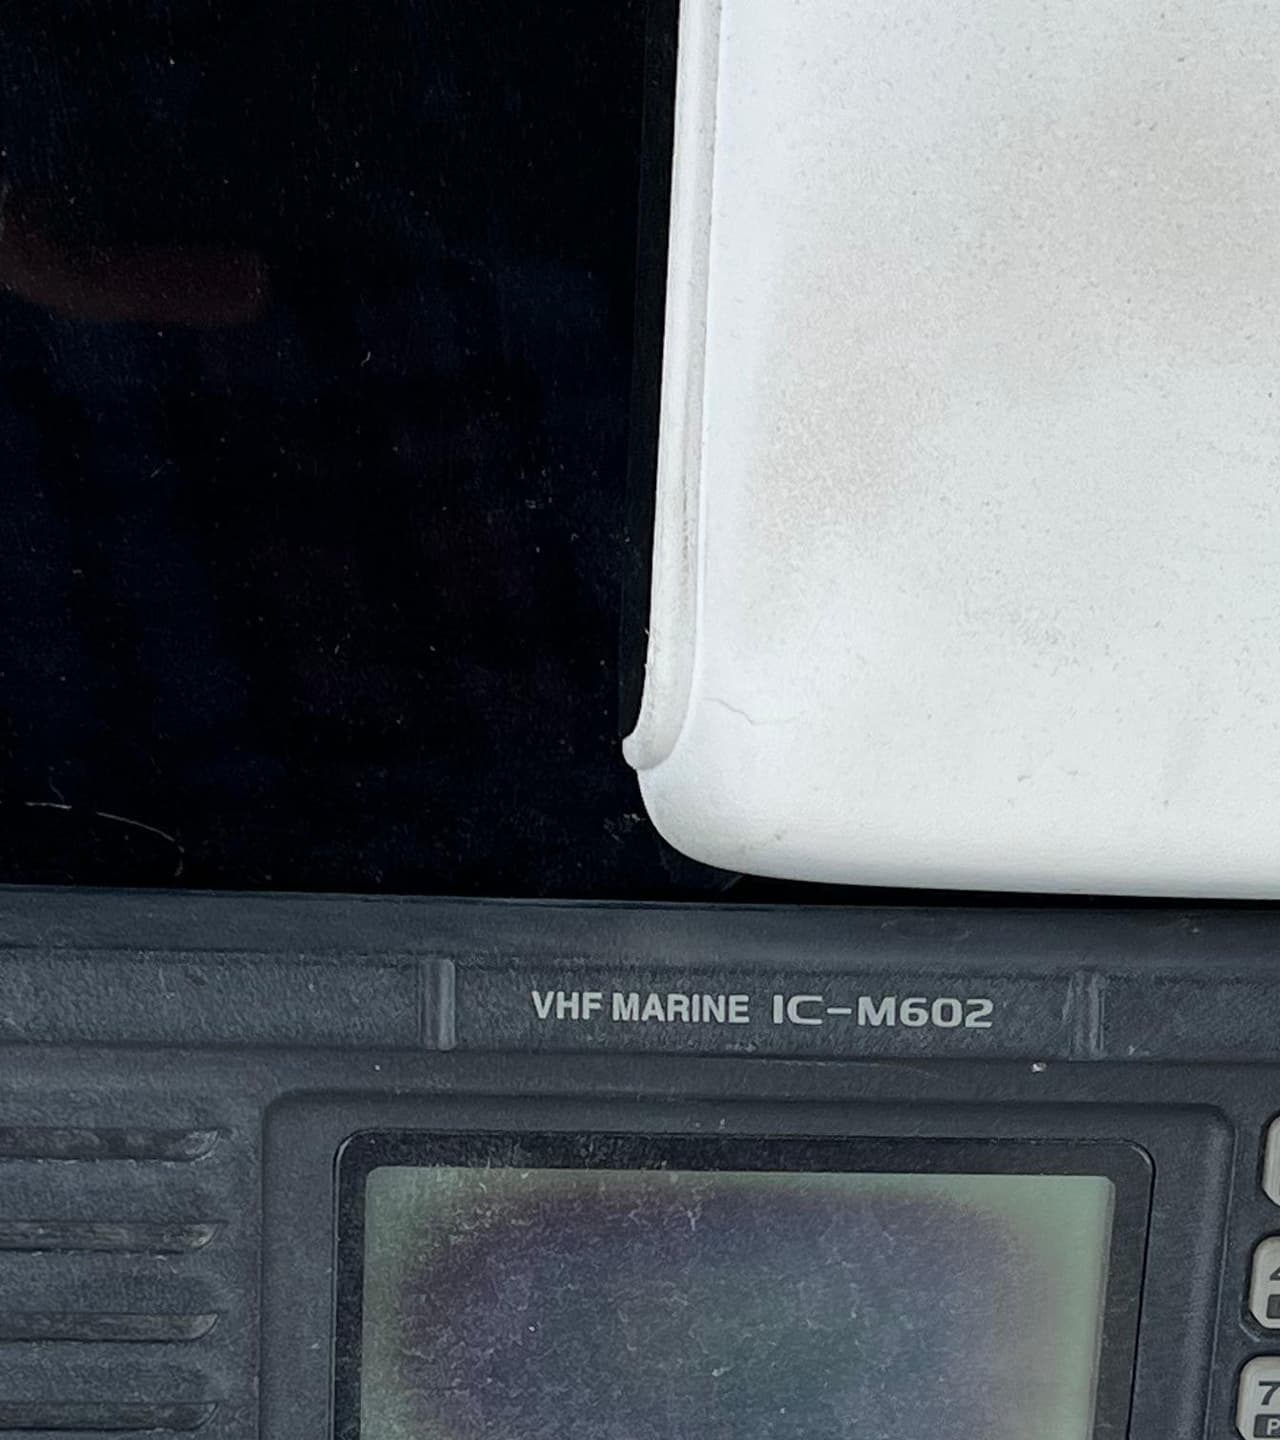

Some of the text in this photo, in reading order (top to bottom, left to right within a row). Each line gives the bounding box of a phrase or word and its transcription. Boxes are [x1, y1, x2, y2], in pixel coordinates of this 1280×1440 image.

[531, 990, 995, 1029] VHF MARINE IC-M602
